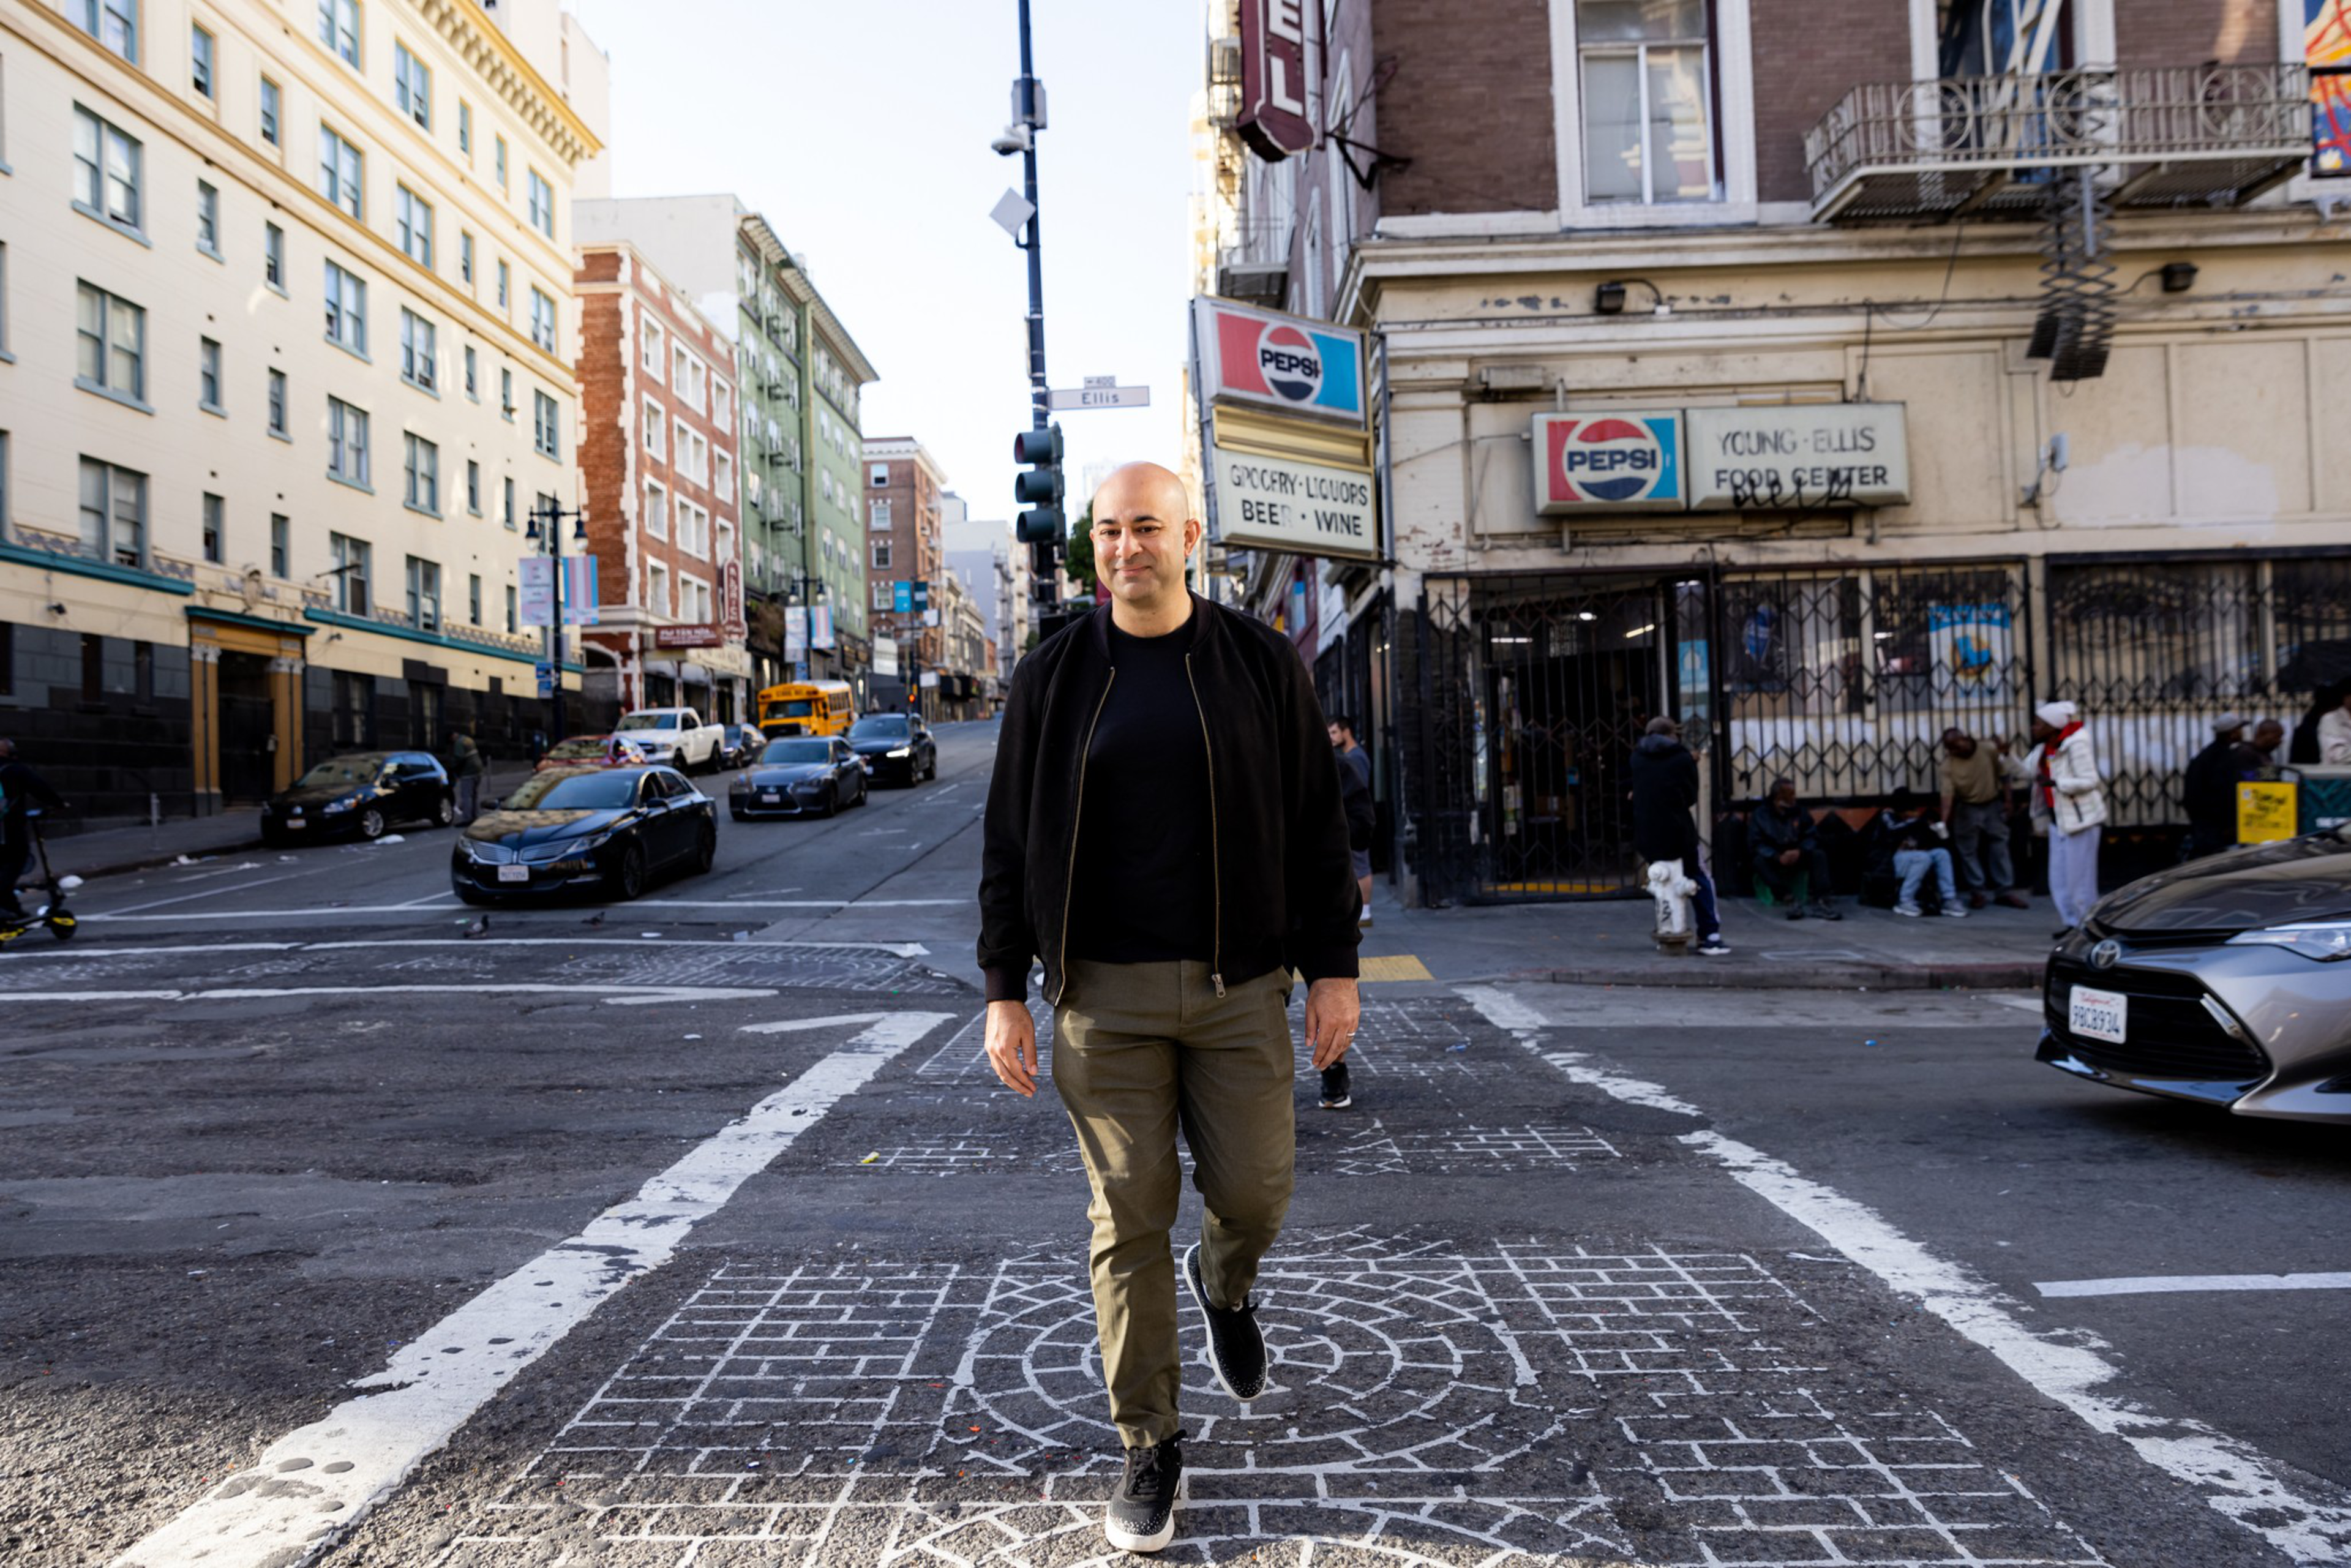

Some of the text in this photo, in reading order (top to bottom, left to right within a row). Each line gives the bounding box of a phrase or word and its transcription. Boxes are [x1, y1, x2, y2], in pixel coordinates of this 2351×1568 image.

[1260, 348, 1319, 379] PEPSI
[1082, 392, 1119, 404] Ellis
[1717, 427, 1876, 456] YOUNG ELLIS
[1567, 449, 1657, 471] PEPSI
[1715, 467, 1780, 489] FOOD
[1314, 509, 1363, 537] WINE
